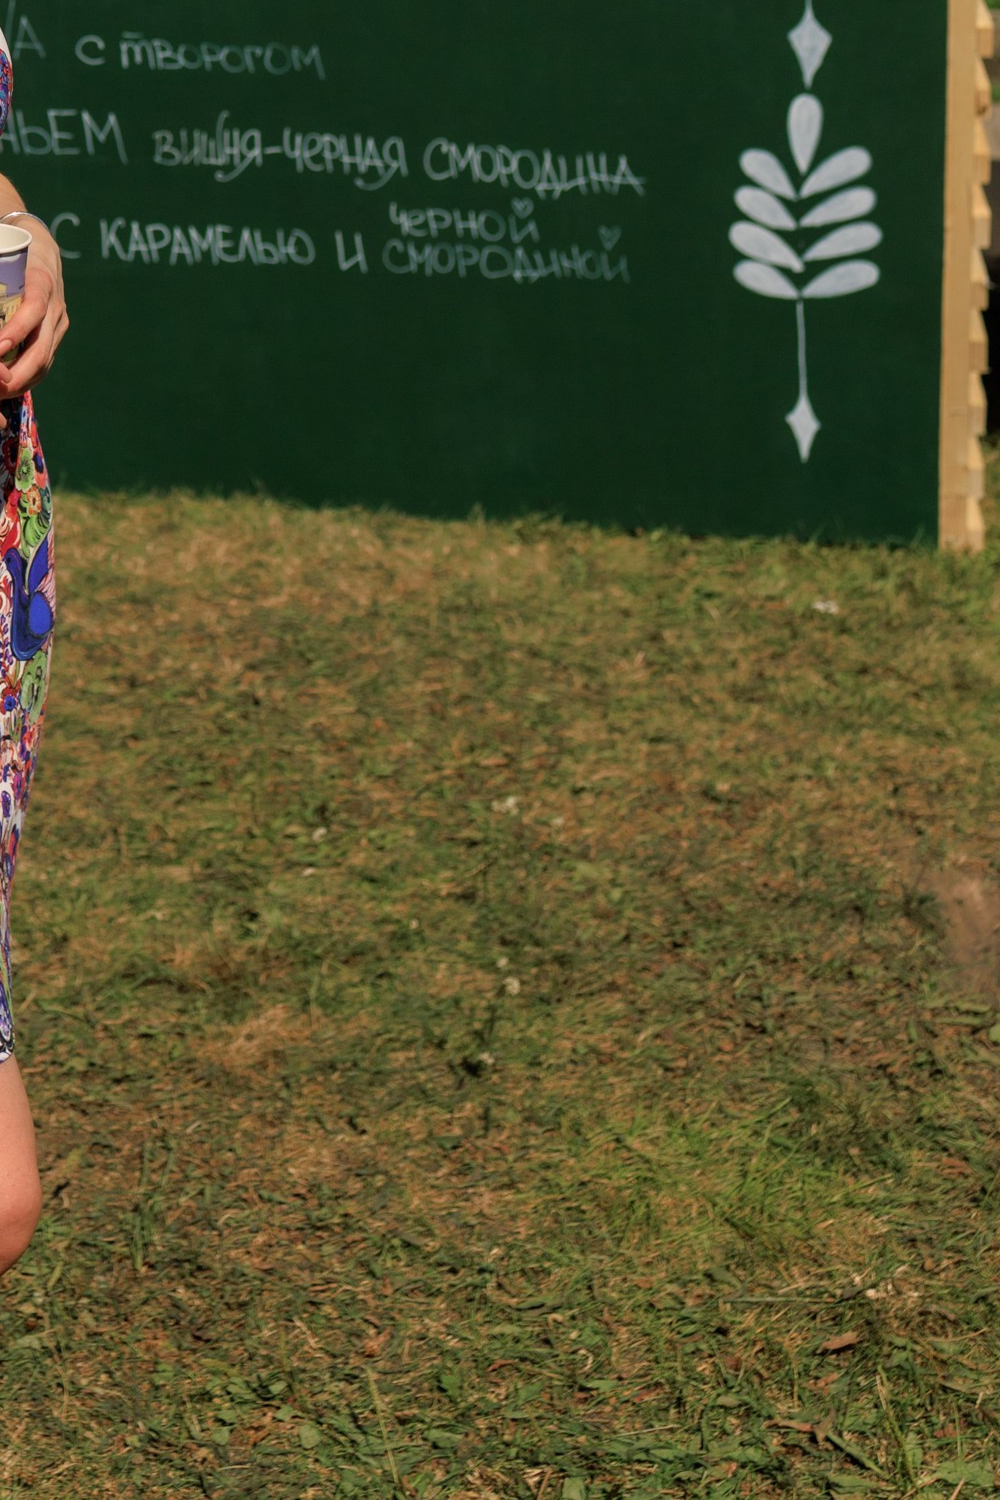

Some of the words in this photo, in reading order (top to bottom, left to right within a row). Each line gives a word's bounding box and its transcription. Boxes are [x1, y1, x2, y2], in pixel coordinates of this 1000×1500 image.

[422, 136, 647, 200] СМОРОДИНА
[99, 216, 317, 267] КАРАМЕЛЬЮ
[333, 228, 369, 275] И
